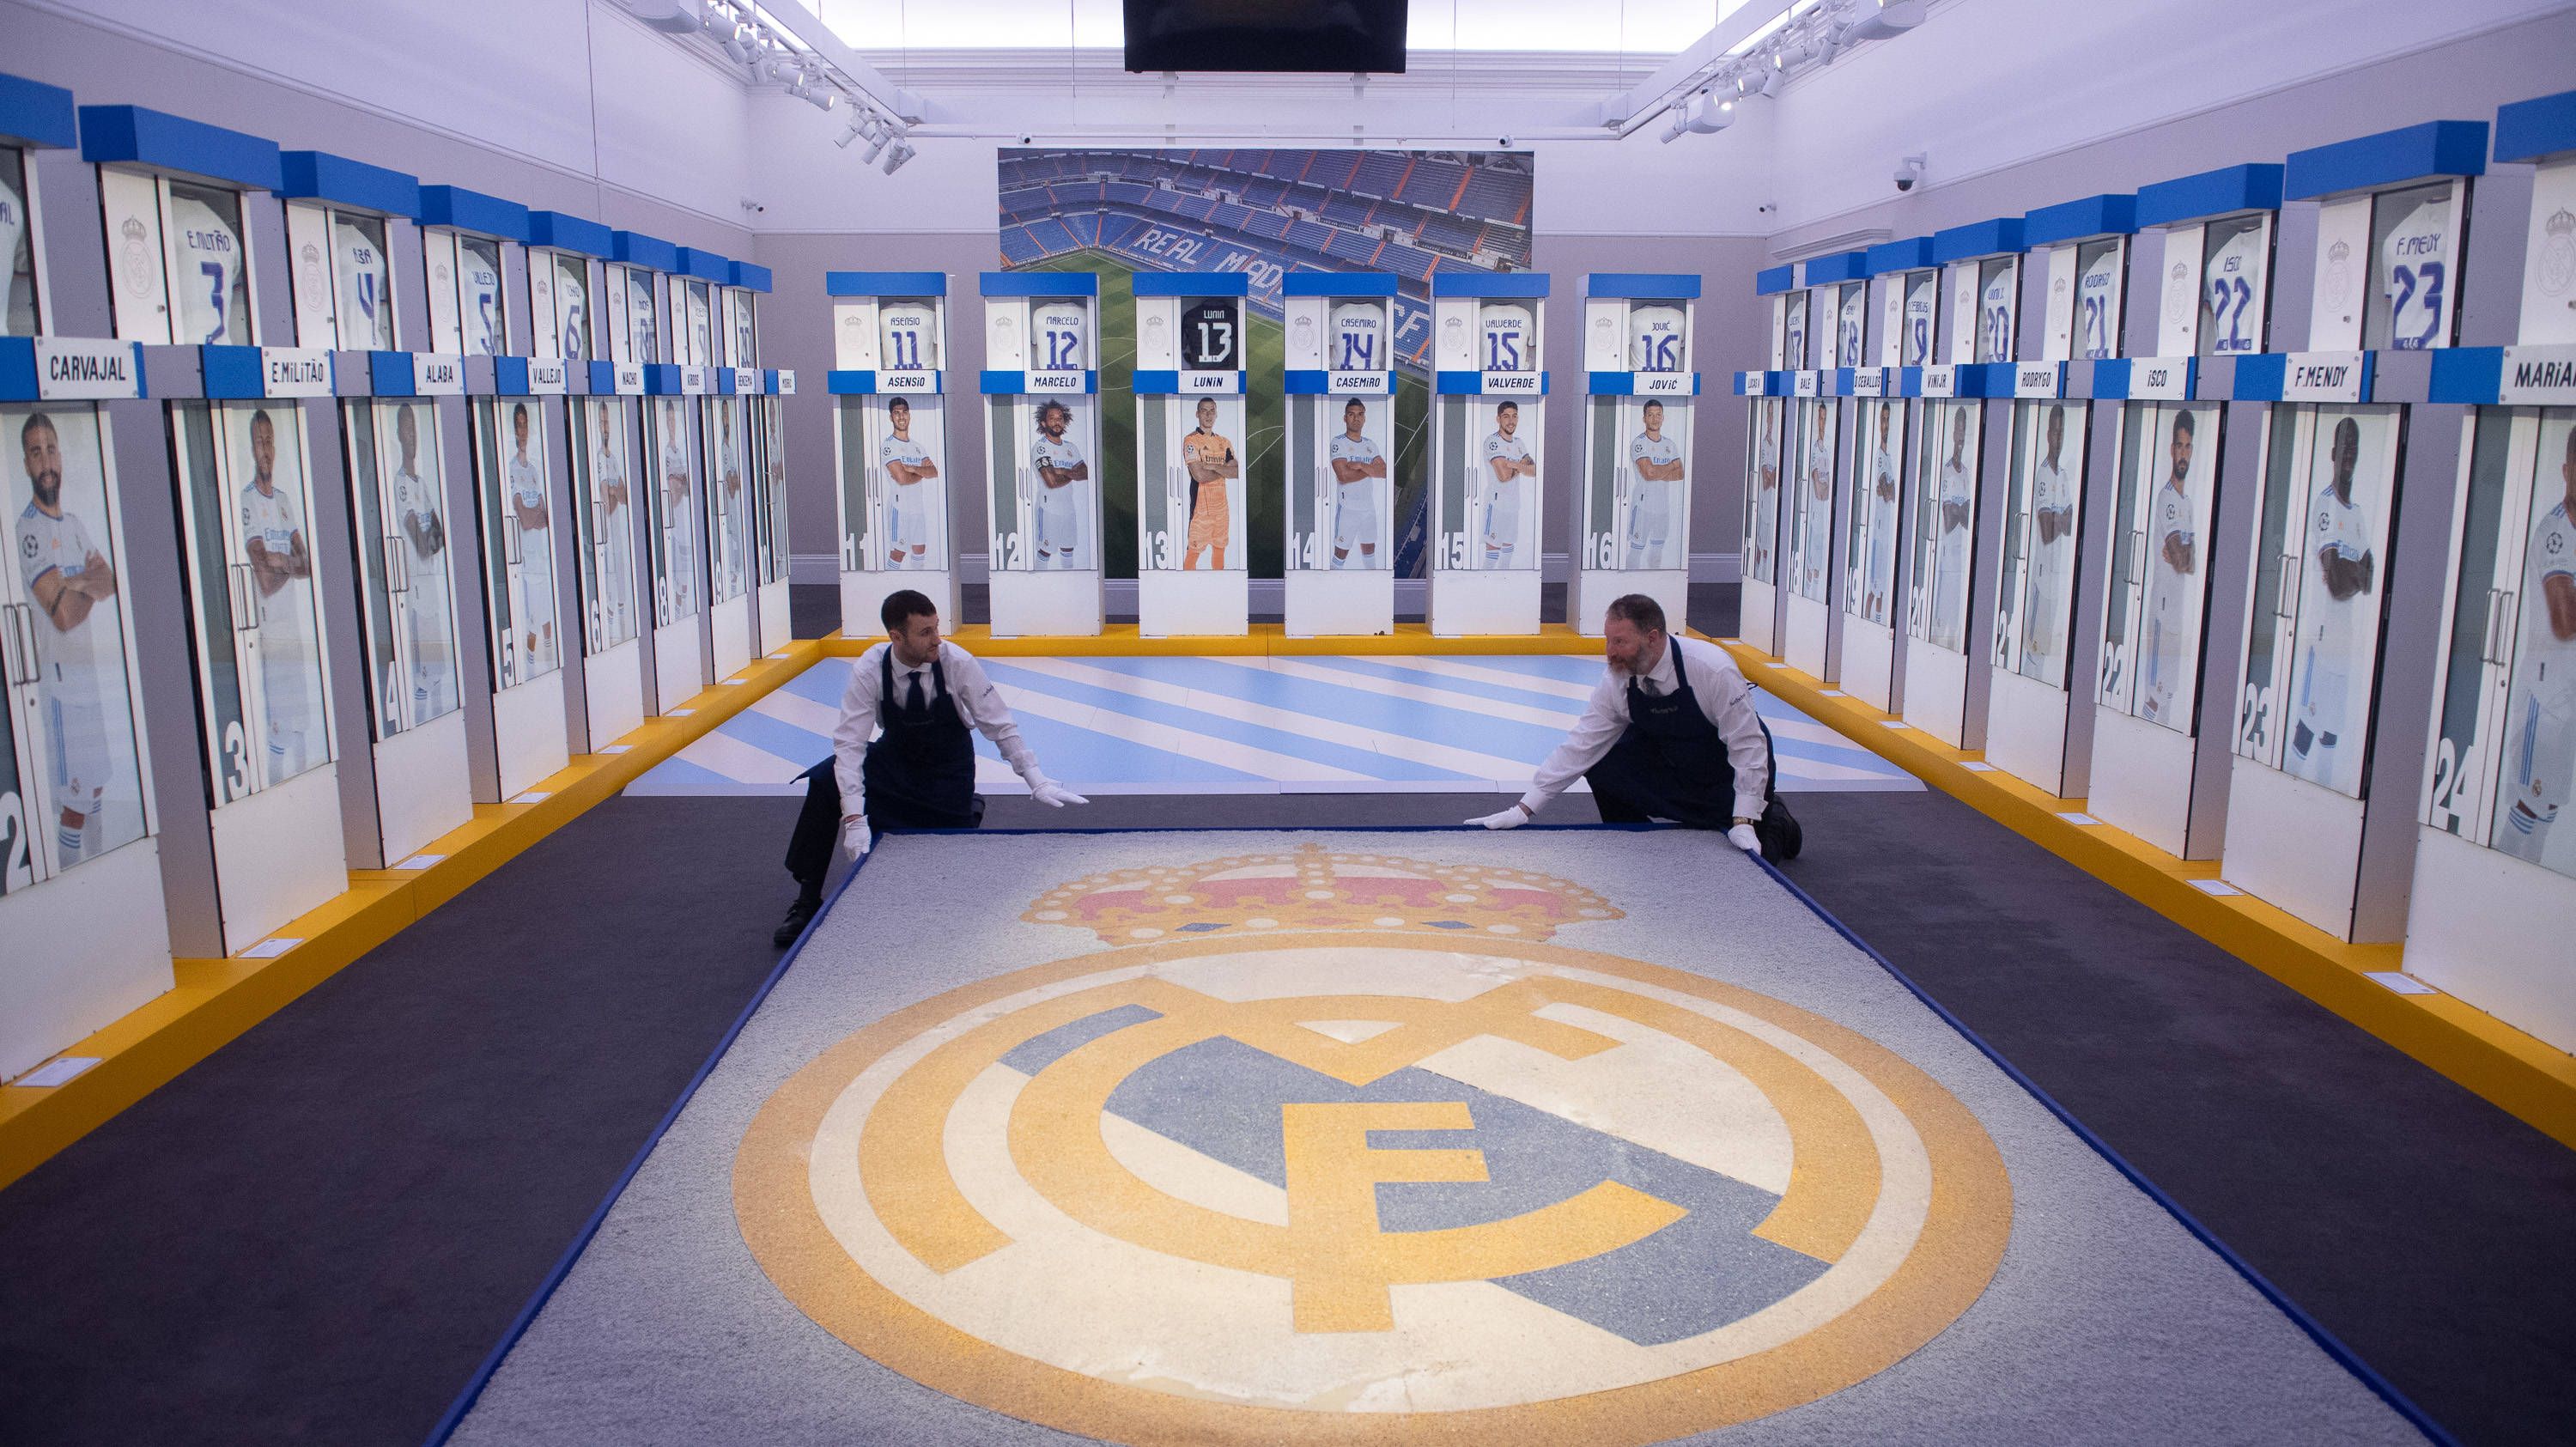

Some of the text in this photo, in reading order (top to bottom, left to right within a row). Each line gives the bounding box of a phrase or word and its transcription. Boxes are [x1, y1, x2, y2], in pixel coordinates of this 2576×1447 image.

[1133, 229, 1203, 264] REAL
[1213, 252, 1284, 295] MAD
[200, 260, 225, 345] 3
[890, 317, 920, 326] ASENSIO
[1046, 316, 1078, 325] MARCELO
[1204, 309, 1224, 319] LUNIN
[2215, 276, 2252, 351] 22
[2391, 260, 2445, 350] 23
[564, 305, 582, 360] 6
[1198, 322, 1232, 362] 13
[1341, 318, 1377, 329] CASEMIRO
[1485, 319, 1522, 329] VALVERDE
[1652, 320, 1670, 331] JOVIĆ
[50, 355, 126, 381] CARVAJAL
[891, 331, 922, 370] 11
[1046, 331, 1078, 370] 12
[1340, 332, 1374, 370] 14
[1486, 331, 1520, 371] 15
[1642, 334, 1679, 371] 16
[426, 364, 454, 383] ALABA
[533, 368, 561, 384] VALLEJO
[622, 371, 637, 385] NACHO
[1034, 376, 1076, 387] MARCELO
[1488, 377, 1534, 388] VALVERDE
[1800, 378, 1811, 389] BALE
[2021, 371, 2051, 388] RODRYGO
[2294, 365, 2348, 387] F.MENDY
[2514, 360, 2576, 387] MARiA
[996, 532, 1018, 570] 12
[1145, 531, 1169, 570] 13
[1292, 532, 1315, 570] 14
[1441, 532, 1463, 570] 15
[1589, 532, 1613, 570] 16
[659, 576, 669, 626] 8
[1911, 586, 1926, 640] 20
[501, 628, 516, 689] 5
[2101, 641, 2127, 712] 22
[386, 660, 403, 732] 4
[2240, 683, 2274, 766] 23
[225, 720, 252, 800] 3
[2432, 738, 2476, 841] 24
[0, 791, 31, 895] 2
